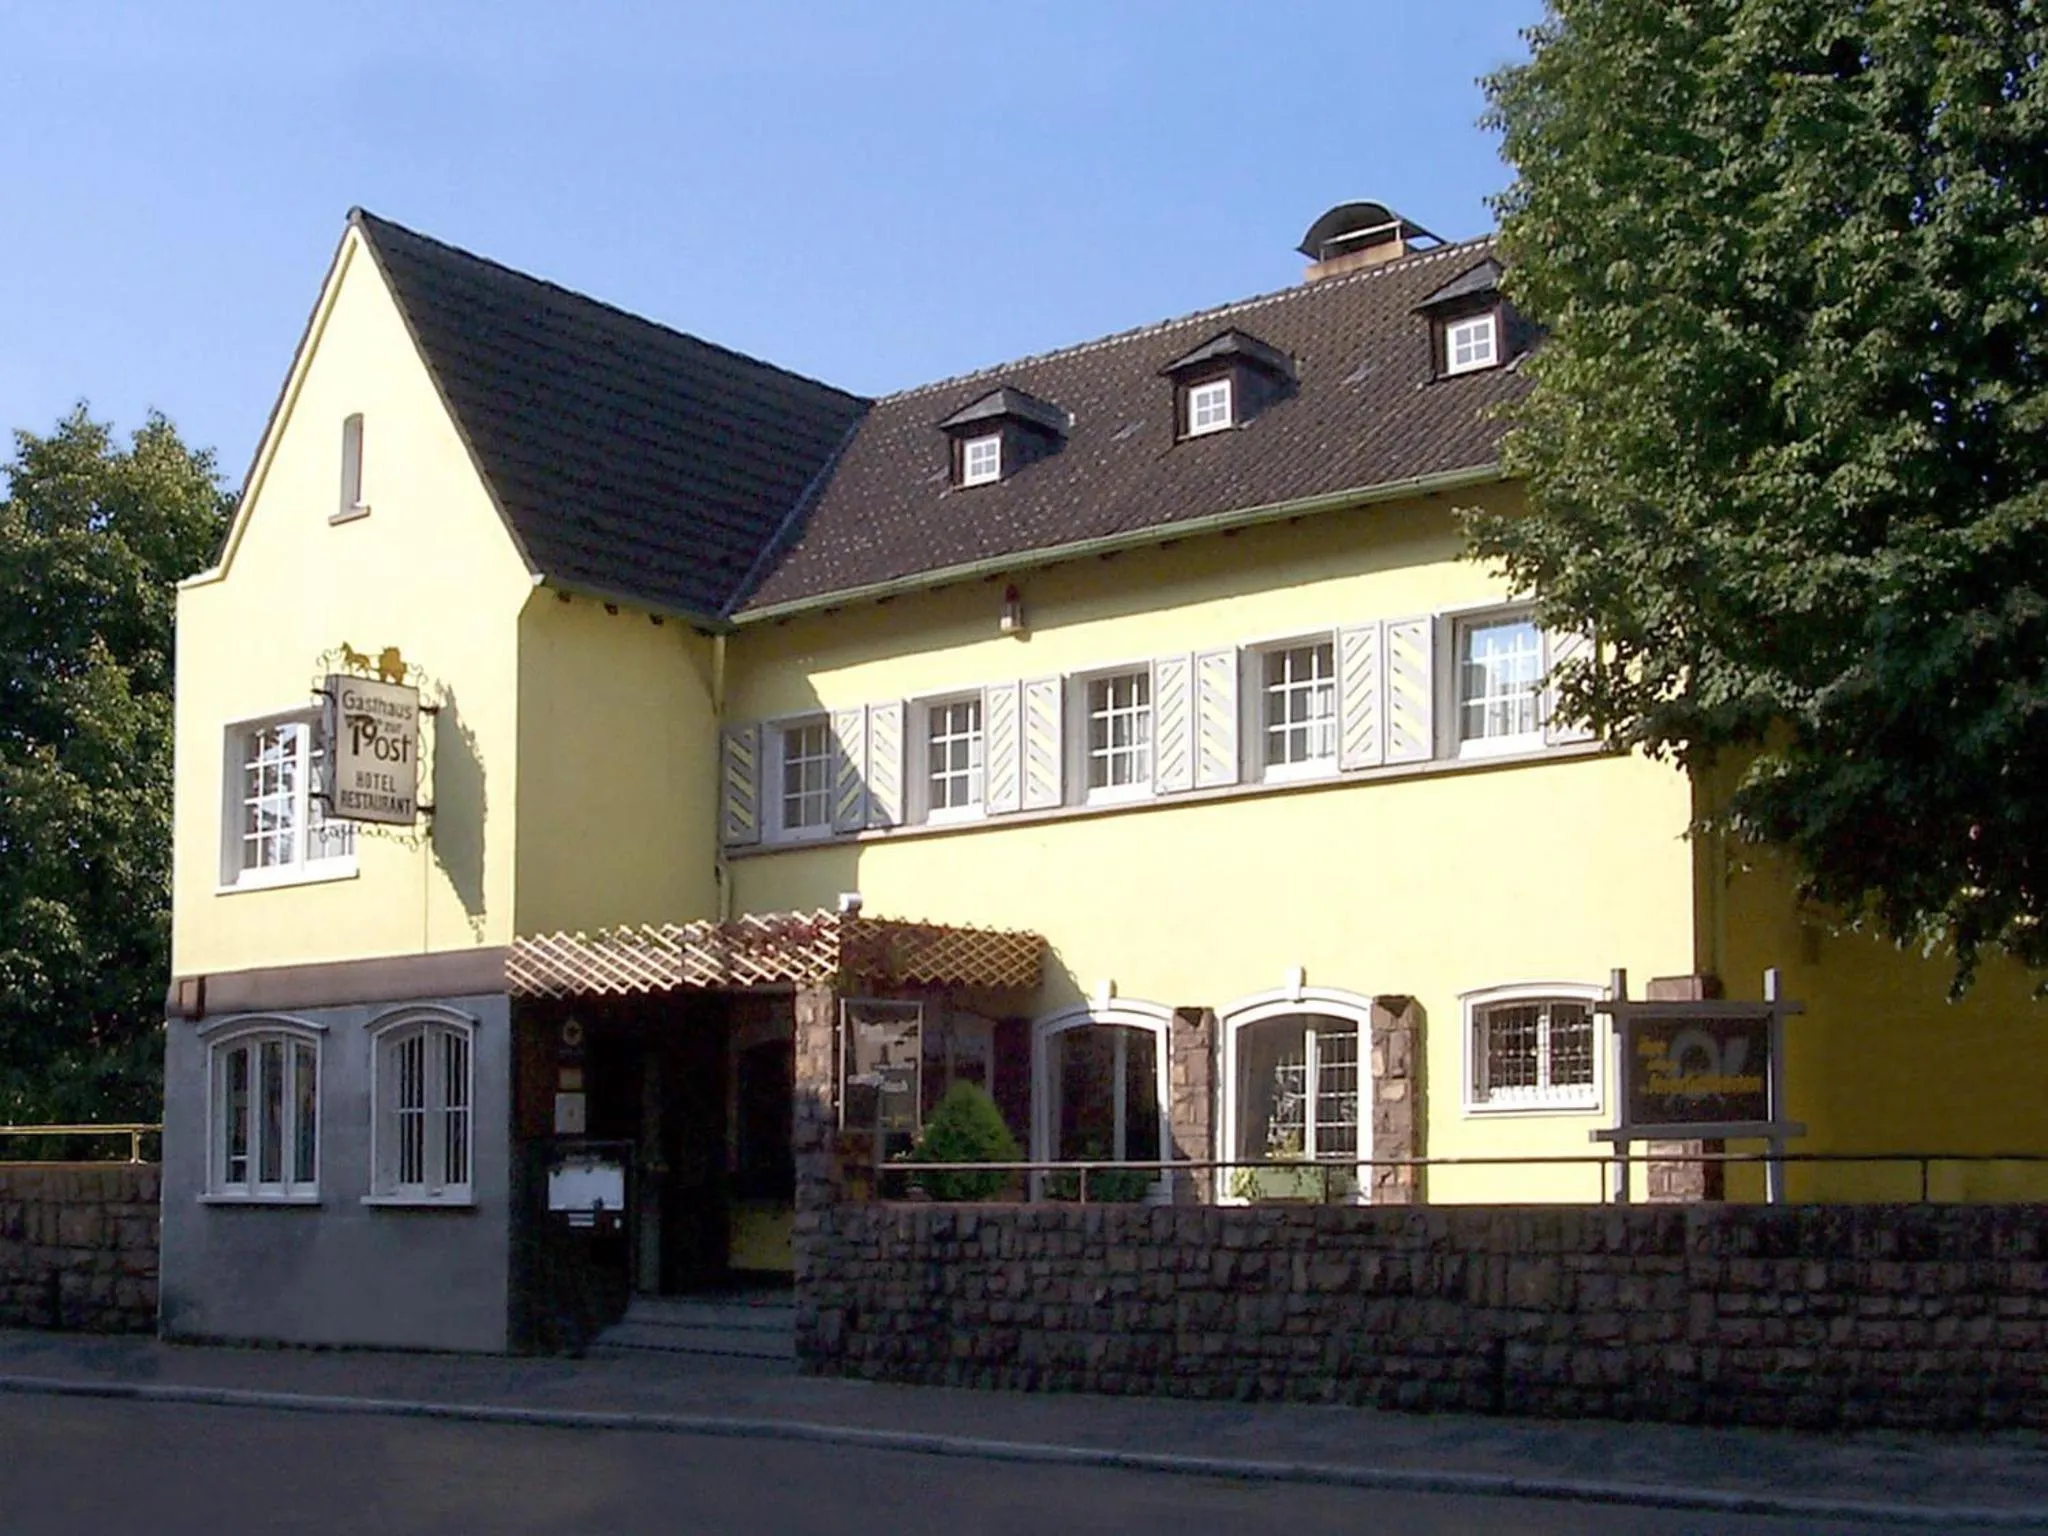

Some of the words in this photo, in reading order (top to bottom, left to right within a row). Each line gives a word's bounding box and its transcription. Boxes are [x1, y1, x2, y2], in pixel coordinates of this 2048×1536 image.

[343, 690, 412, 720] Gasthaus
[344, 714, 412, 763] Post
[356, 771, 396, 793] HOTEL
[341, 790, 411, 816] RESTAURANT
